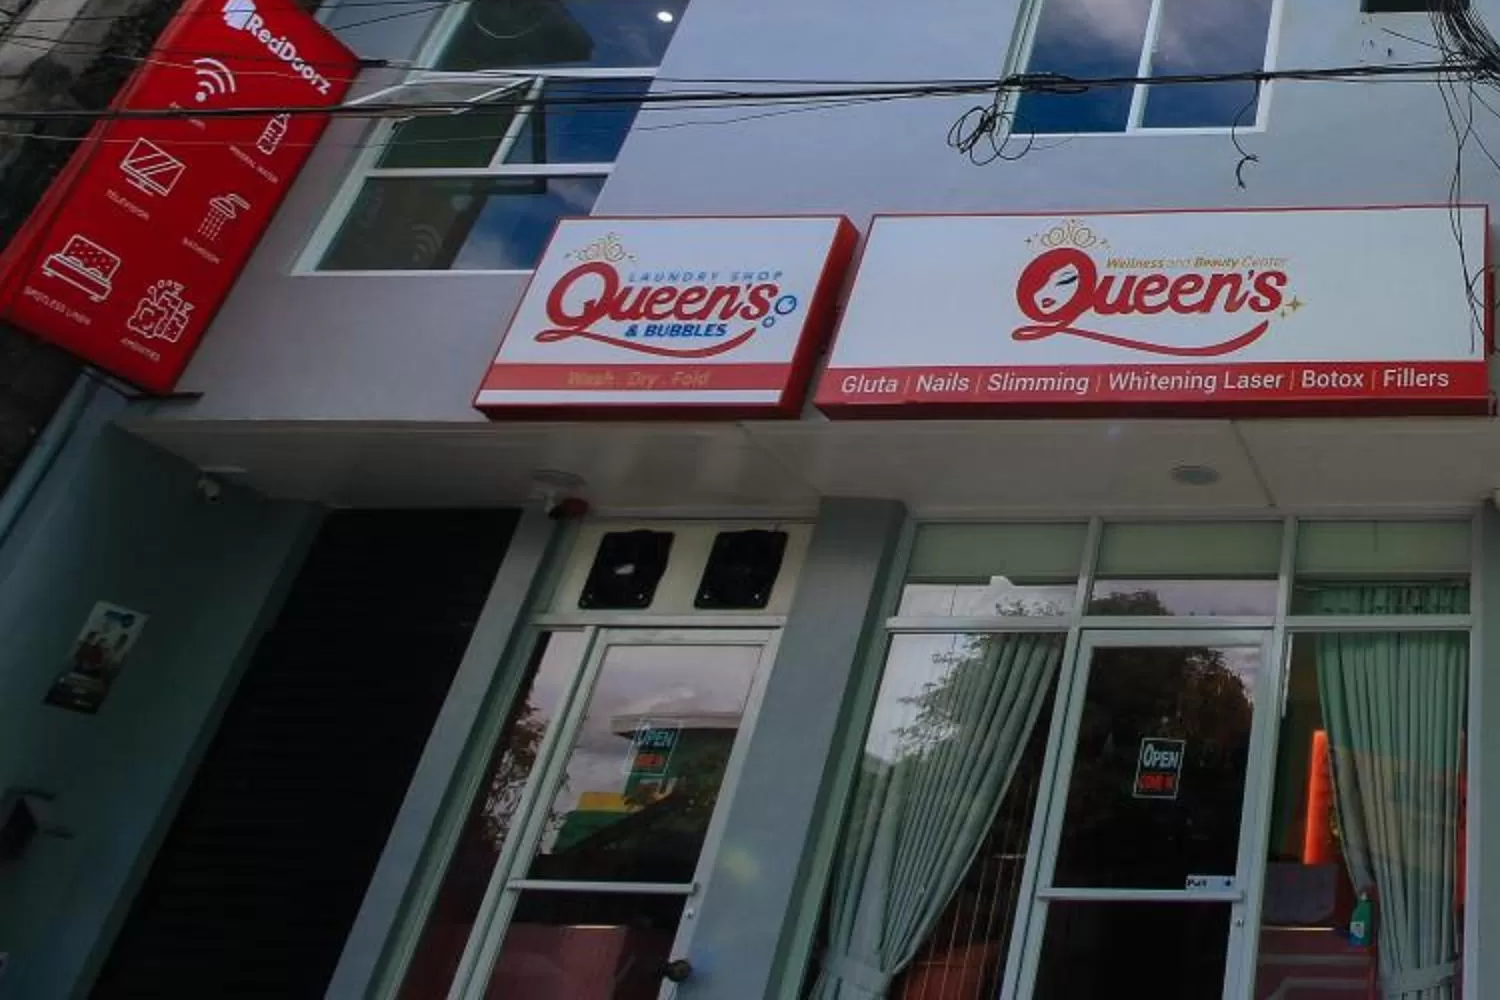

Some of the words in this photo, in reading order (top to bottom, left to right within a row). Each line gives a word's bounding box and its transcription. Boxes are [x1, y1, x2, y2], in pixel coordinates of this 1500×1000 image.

[248, 12, 332, 96] RedDoorz
[1106, 256, 1165, 269] Wellness
[1166, 258, 1191, 269] and
[1193, 256, 1238, 271] Beauty
[1239, 256, 1288, 269] Center
[628, 271, 720, 283] LAUNDRY
[730, 270, 784, 283] SHOP
[535, 261, 780, 358] Queen's
[1011, 247, 1289, 357] Queen's
[624, 324, 636, 338] &
[643, 323, 729, 338] BUBBLES
[567, 371, 616, 385] Wash
[627, 371, 658, 388] Dry
[671, 370, 713, 385] Fold
[840, 375, 899, 393] Gluta
[915, 373, 971, 393] Nails
[986, 372, 1090, 395] Slimming
[1107, 370, 1218, 394] Whitening
[1223, 371, 1285, 390] Laser
[1301, 369, 1366, 389] Botox
[1382, 368, 1450, 388] Fillers
[1143, 743, 1180, 768] OPEN
